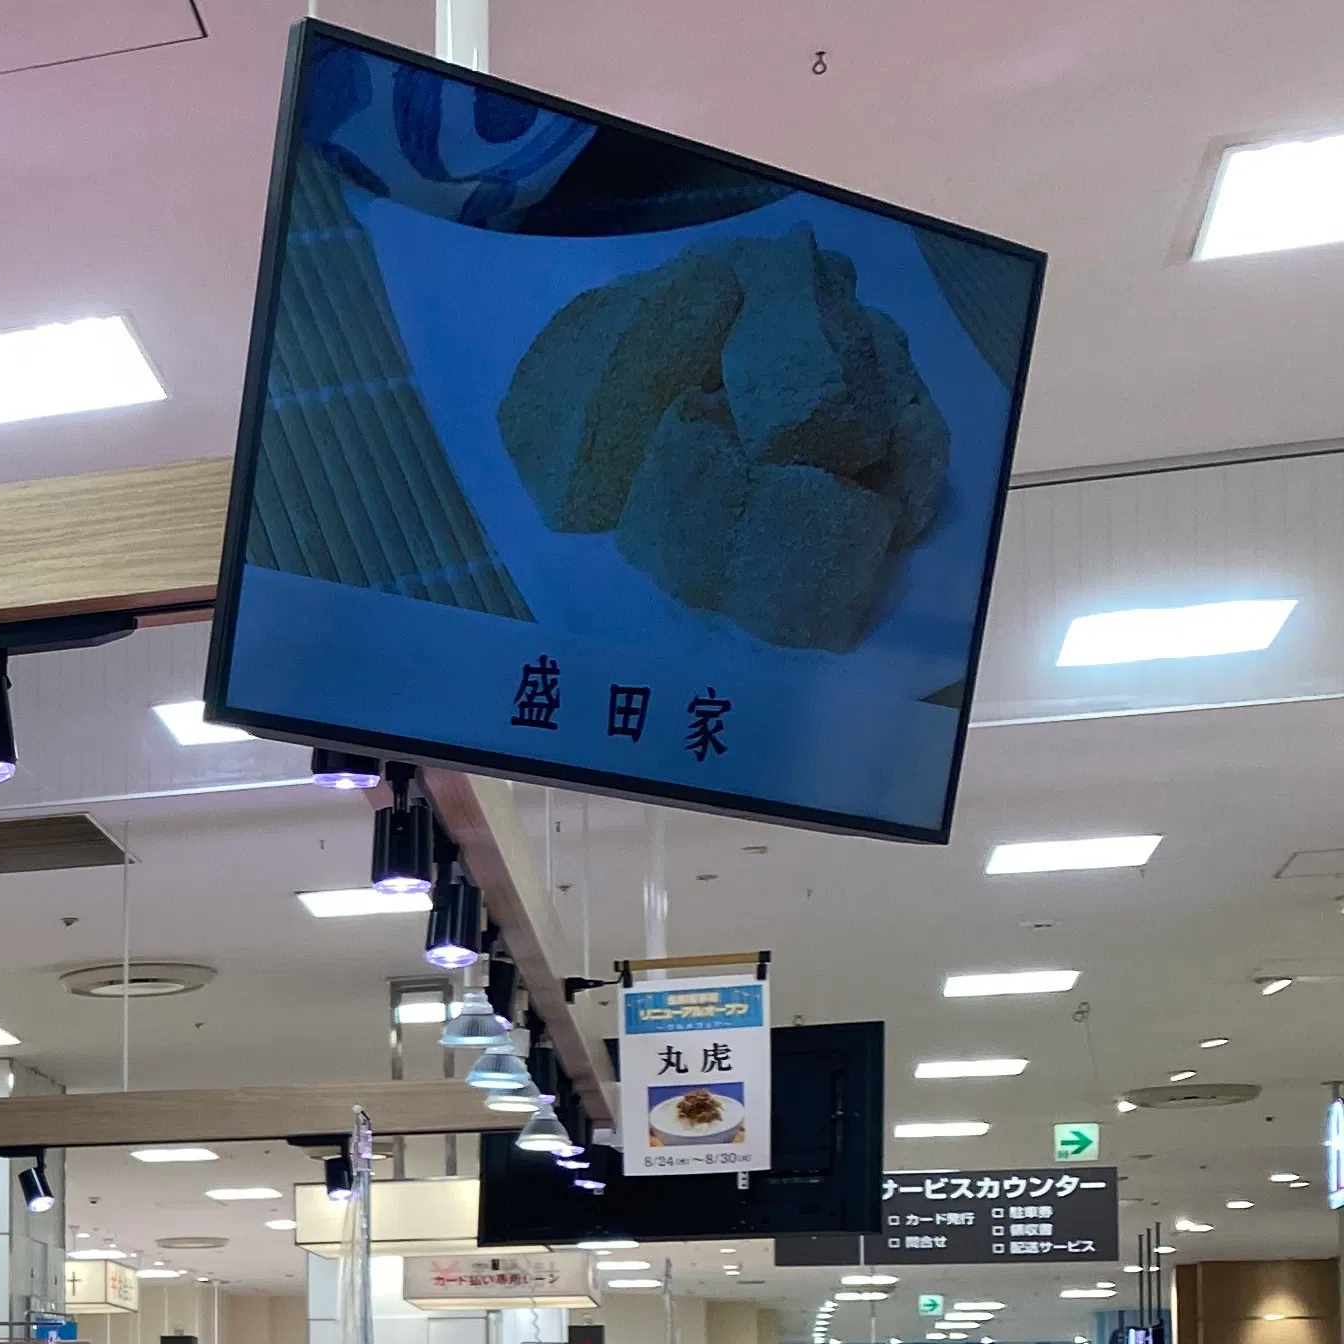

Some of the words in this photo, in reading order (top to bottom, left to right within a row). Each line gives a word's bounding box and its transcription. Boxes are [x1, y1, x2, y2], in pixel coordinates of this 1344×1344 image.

[510, 654, 732, 762] 盛田家
[658, 1043, 733, 1075] 丸虎
